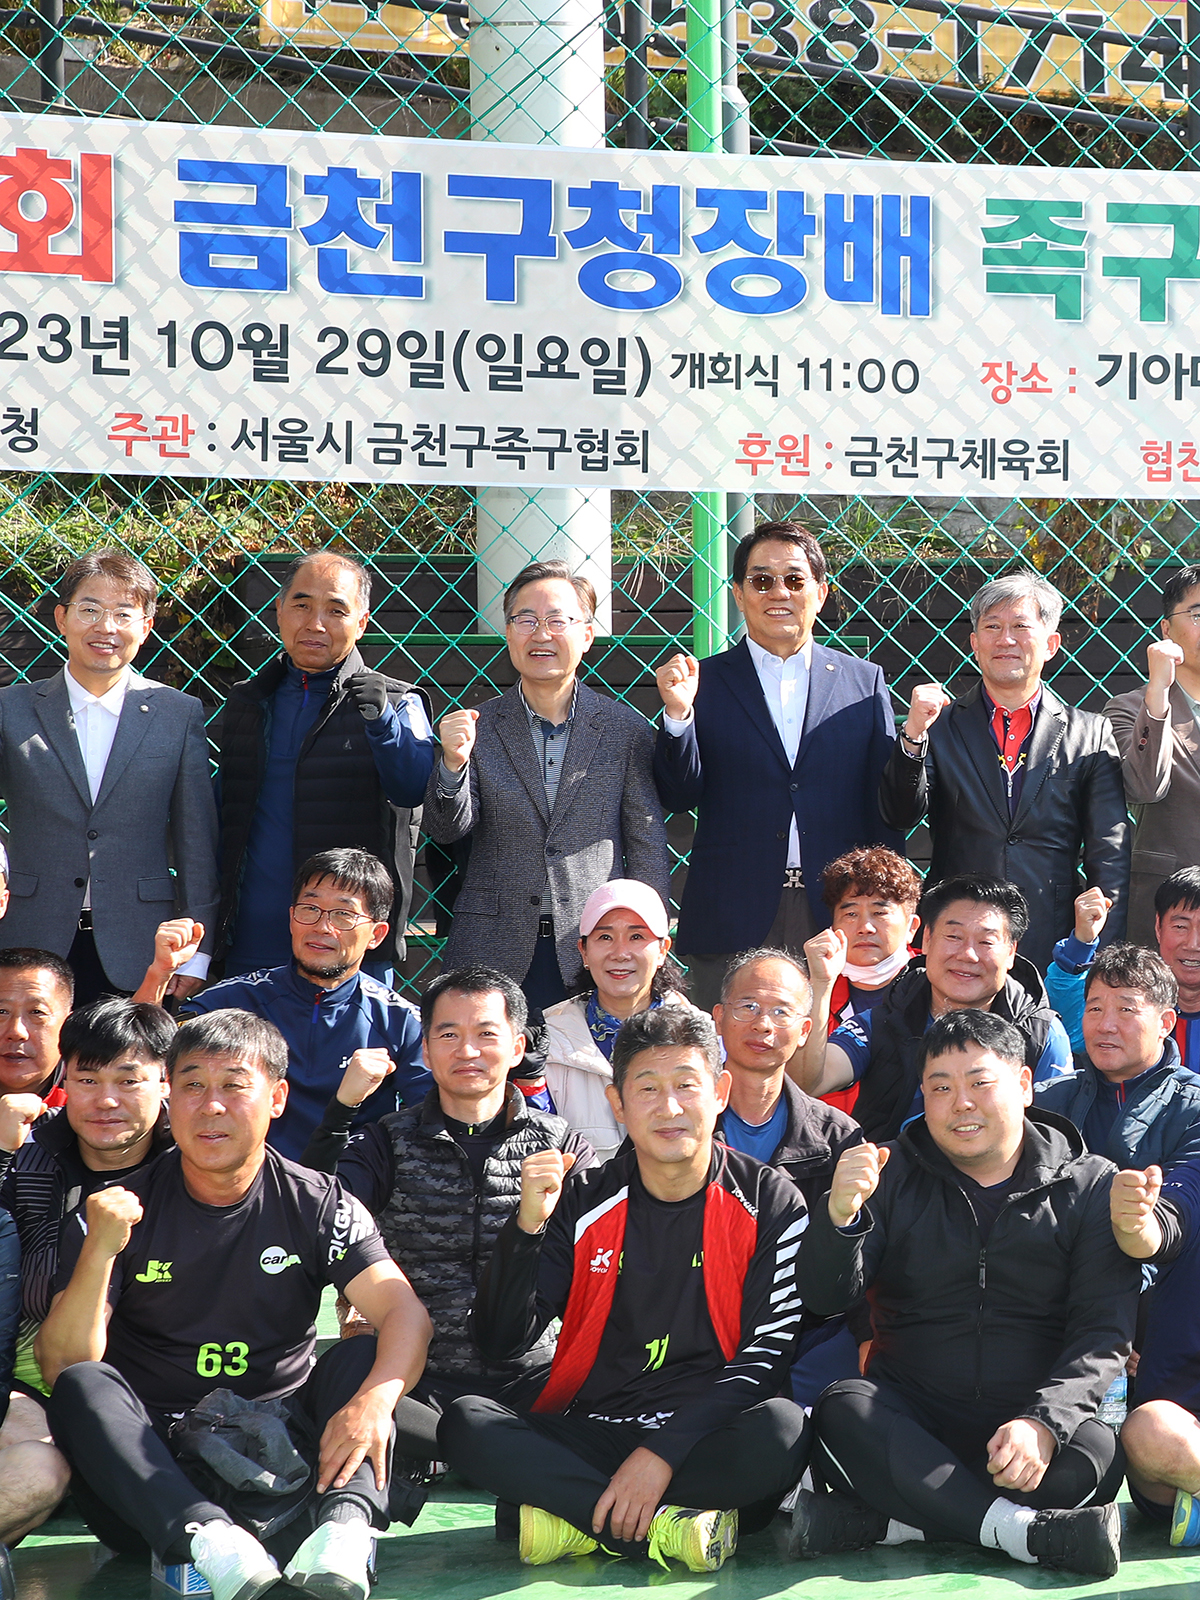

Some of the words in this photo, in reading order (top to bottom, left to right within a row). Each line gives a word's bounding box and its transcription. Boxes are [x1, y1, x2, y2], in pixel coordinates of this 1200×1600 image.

[0, 146, 114, 284] 회
[172, 156, 933, 317] 금천구청장배
[0, 312, 130, 377] 23년
[157, 320, 290, 384] 10월
[315, 326, 653, 398] 29일(일요일)
[669, 352, 779, 398] 개회식
[797, 357, 920, 395] 11:00
[229, 417, 354, 465] 서울시
[366, 422, 650, 473] 금천구족구협회
[844, 436, 1070, 482] 금천구체육회
[196, 1340, 250, 1378] 63
